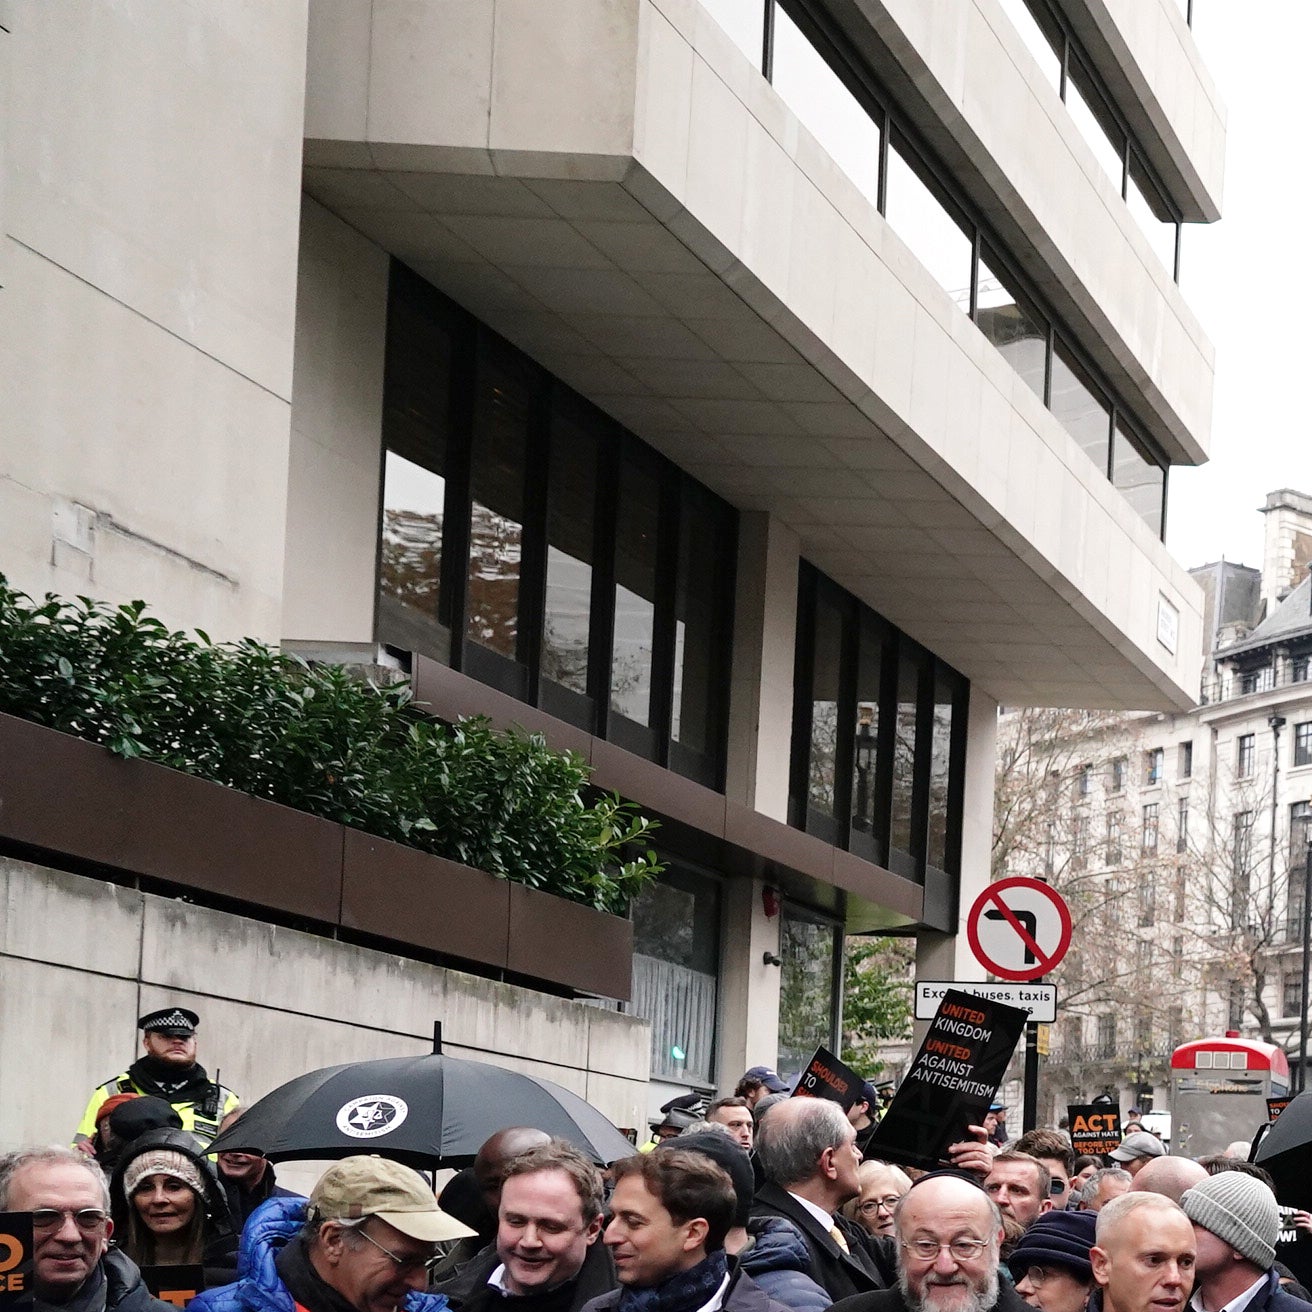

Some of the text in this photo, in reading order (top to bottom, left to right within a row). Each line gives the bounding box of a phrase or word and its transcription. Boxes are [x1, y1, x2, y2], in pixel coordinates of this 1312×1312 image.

[1019, 990, 1050, 1001] taxis
[941, 1002, 985, 1025] UNITED
[934, 1017, 992, 1042] KINGDOM
[925, 1039, 971, 1060] UNITED
[811, 1061, 848, 1093] SHOULDER
[918, 1054, 974, 1077] AGAINST
[804, 1074, 817, 1088] TO
[911, 1068, 995, 1098] ANTISEMITISM
[1072, 1114, 1117, 1132] ACT
